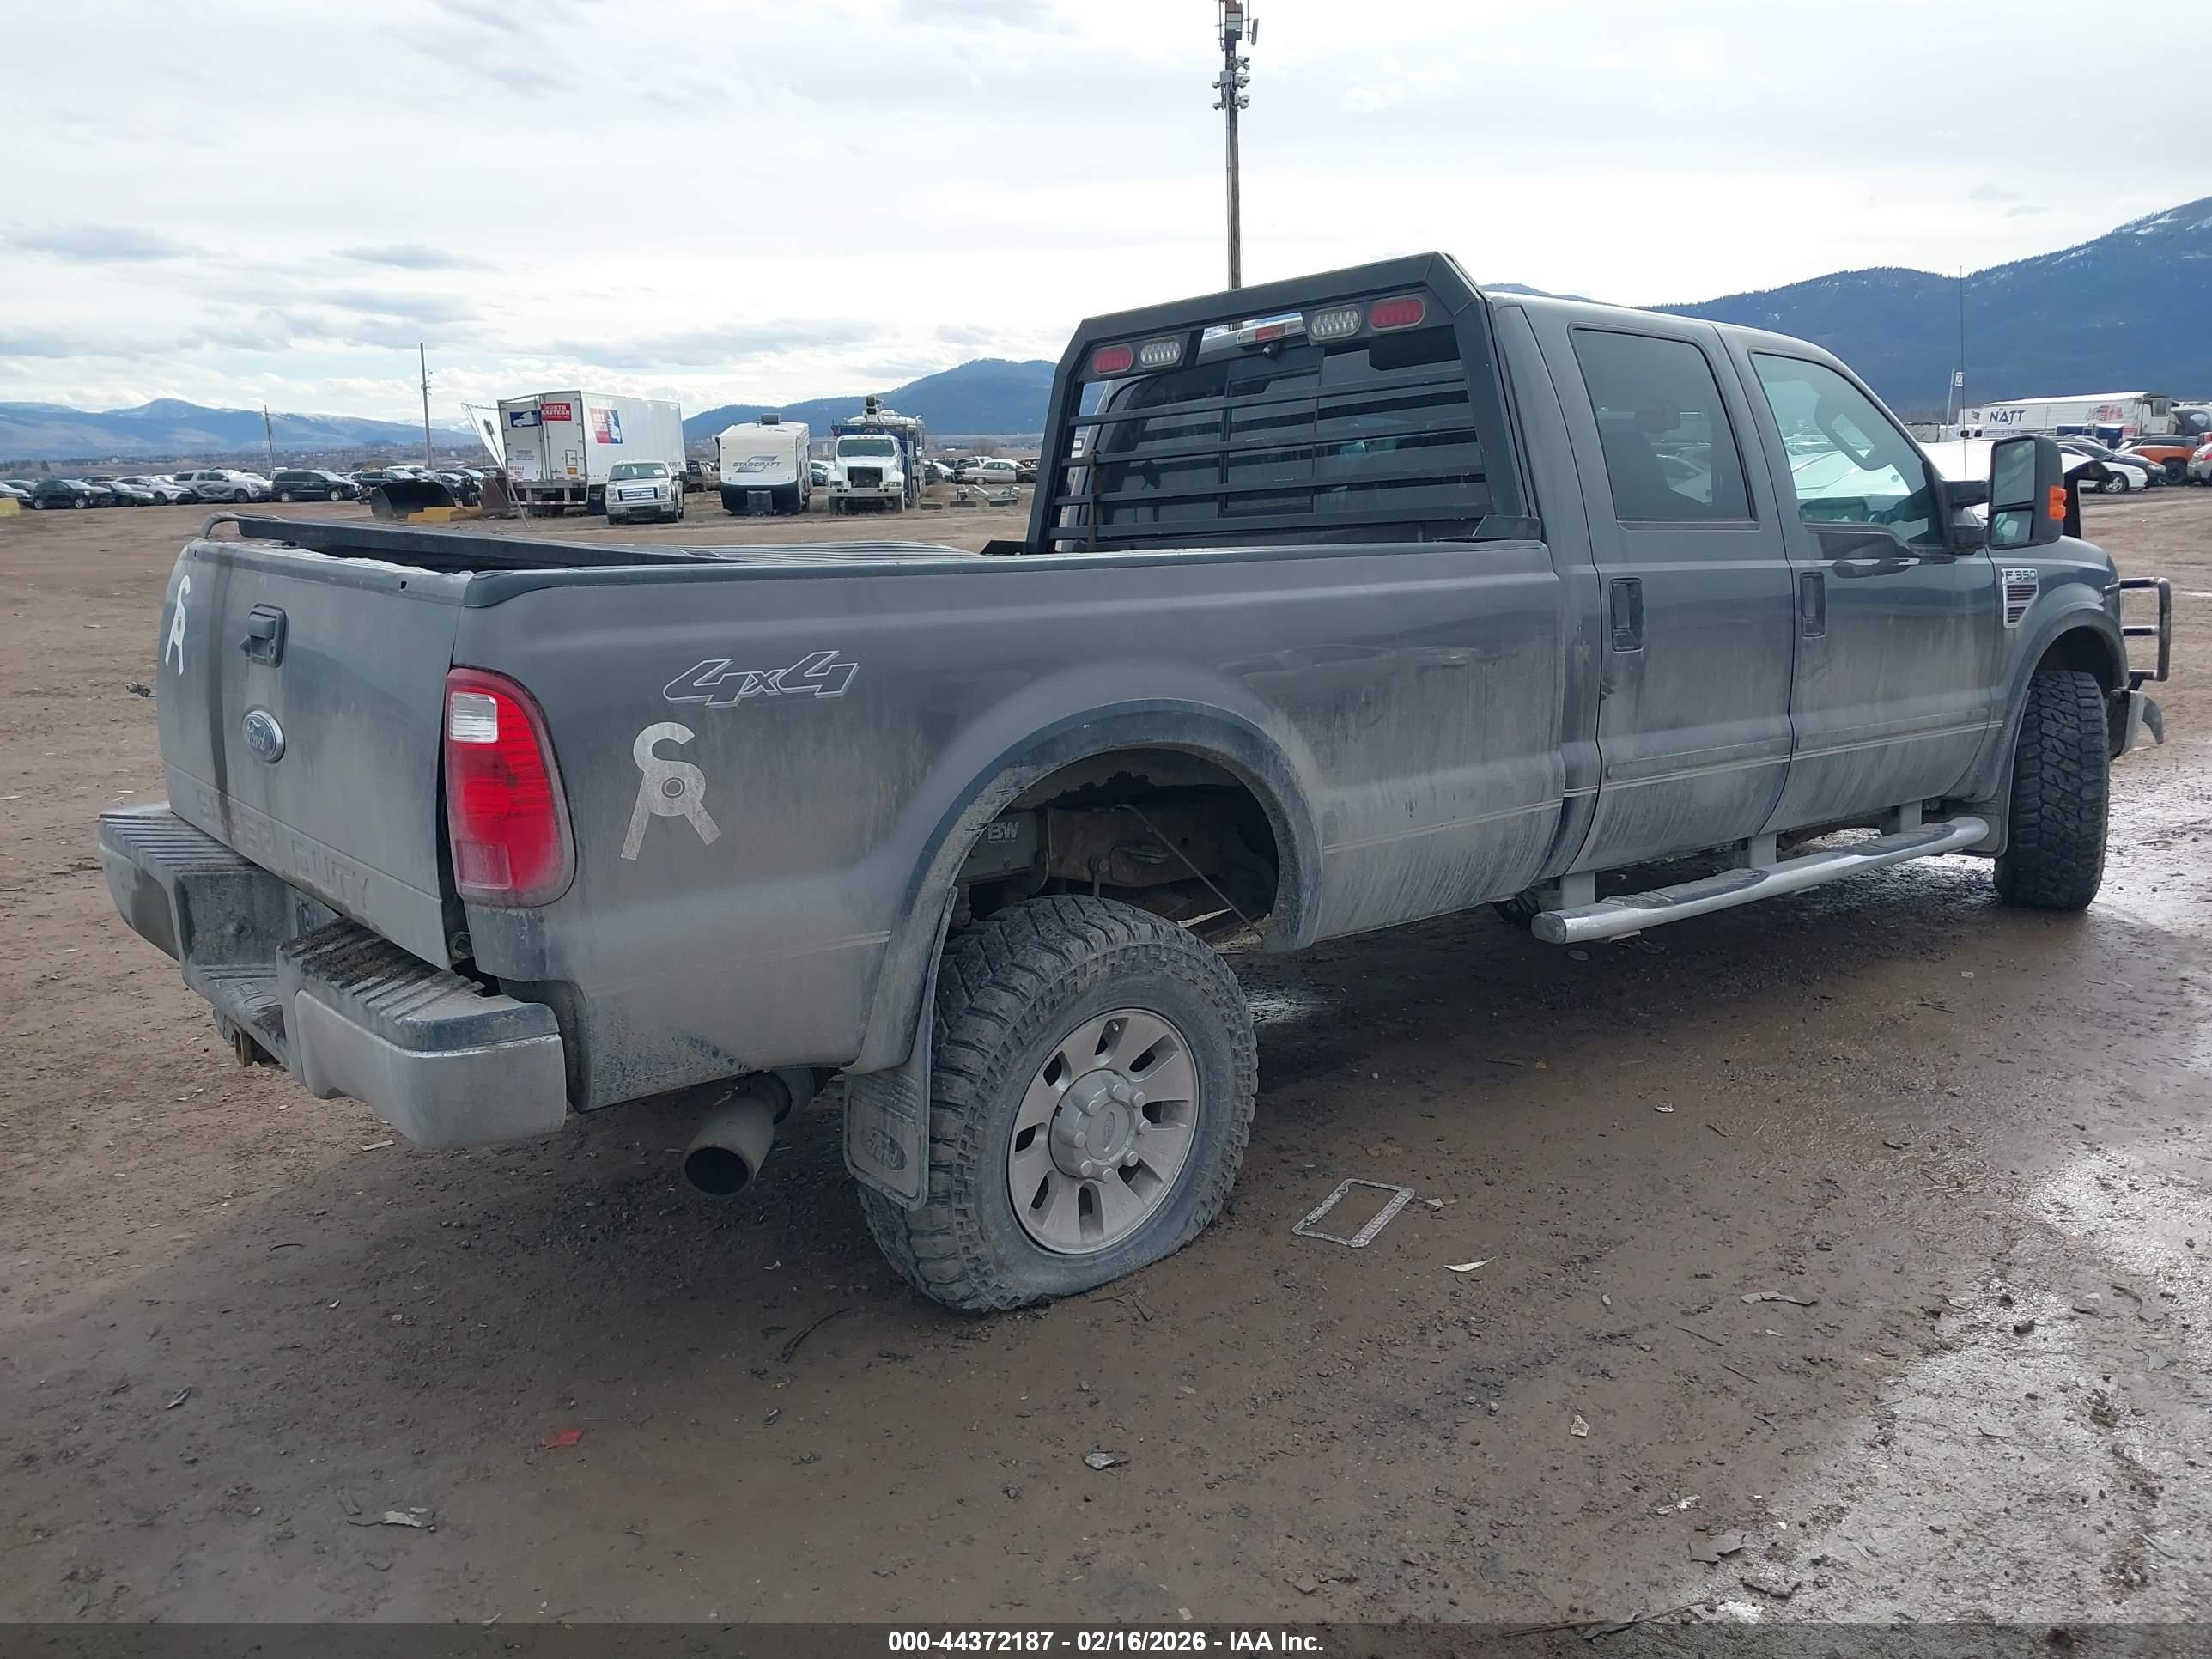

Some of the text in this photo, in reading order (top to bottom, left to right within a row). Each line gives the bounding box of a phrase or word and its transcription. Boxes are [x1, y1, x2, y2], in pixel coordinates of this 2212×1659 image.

[1990, 410, 2027, 425] NATT
[2006, 570, 2036, 580] F-350
[663, 650, 859, 708] 4x4
[246, 719, 266, 751] Ford
